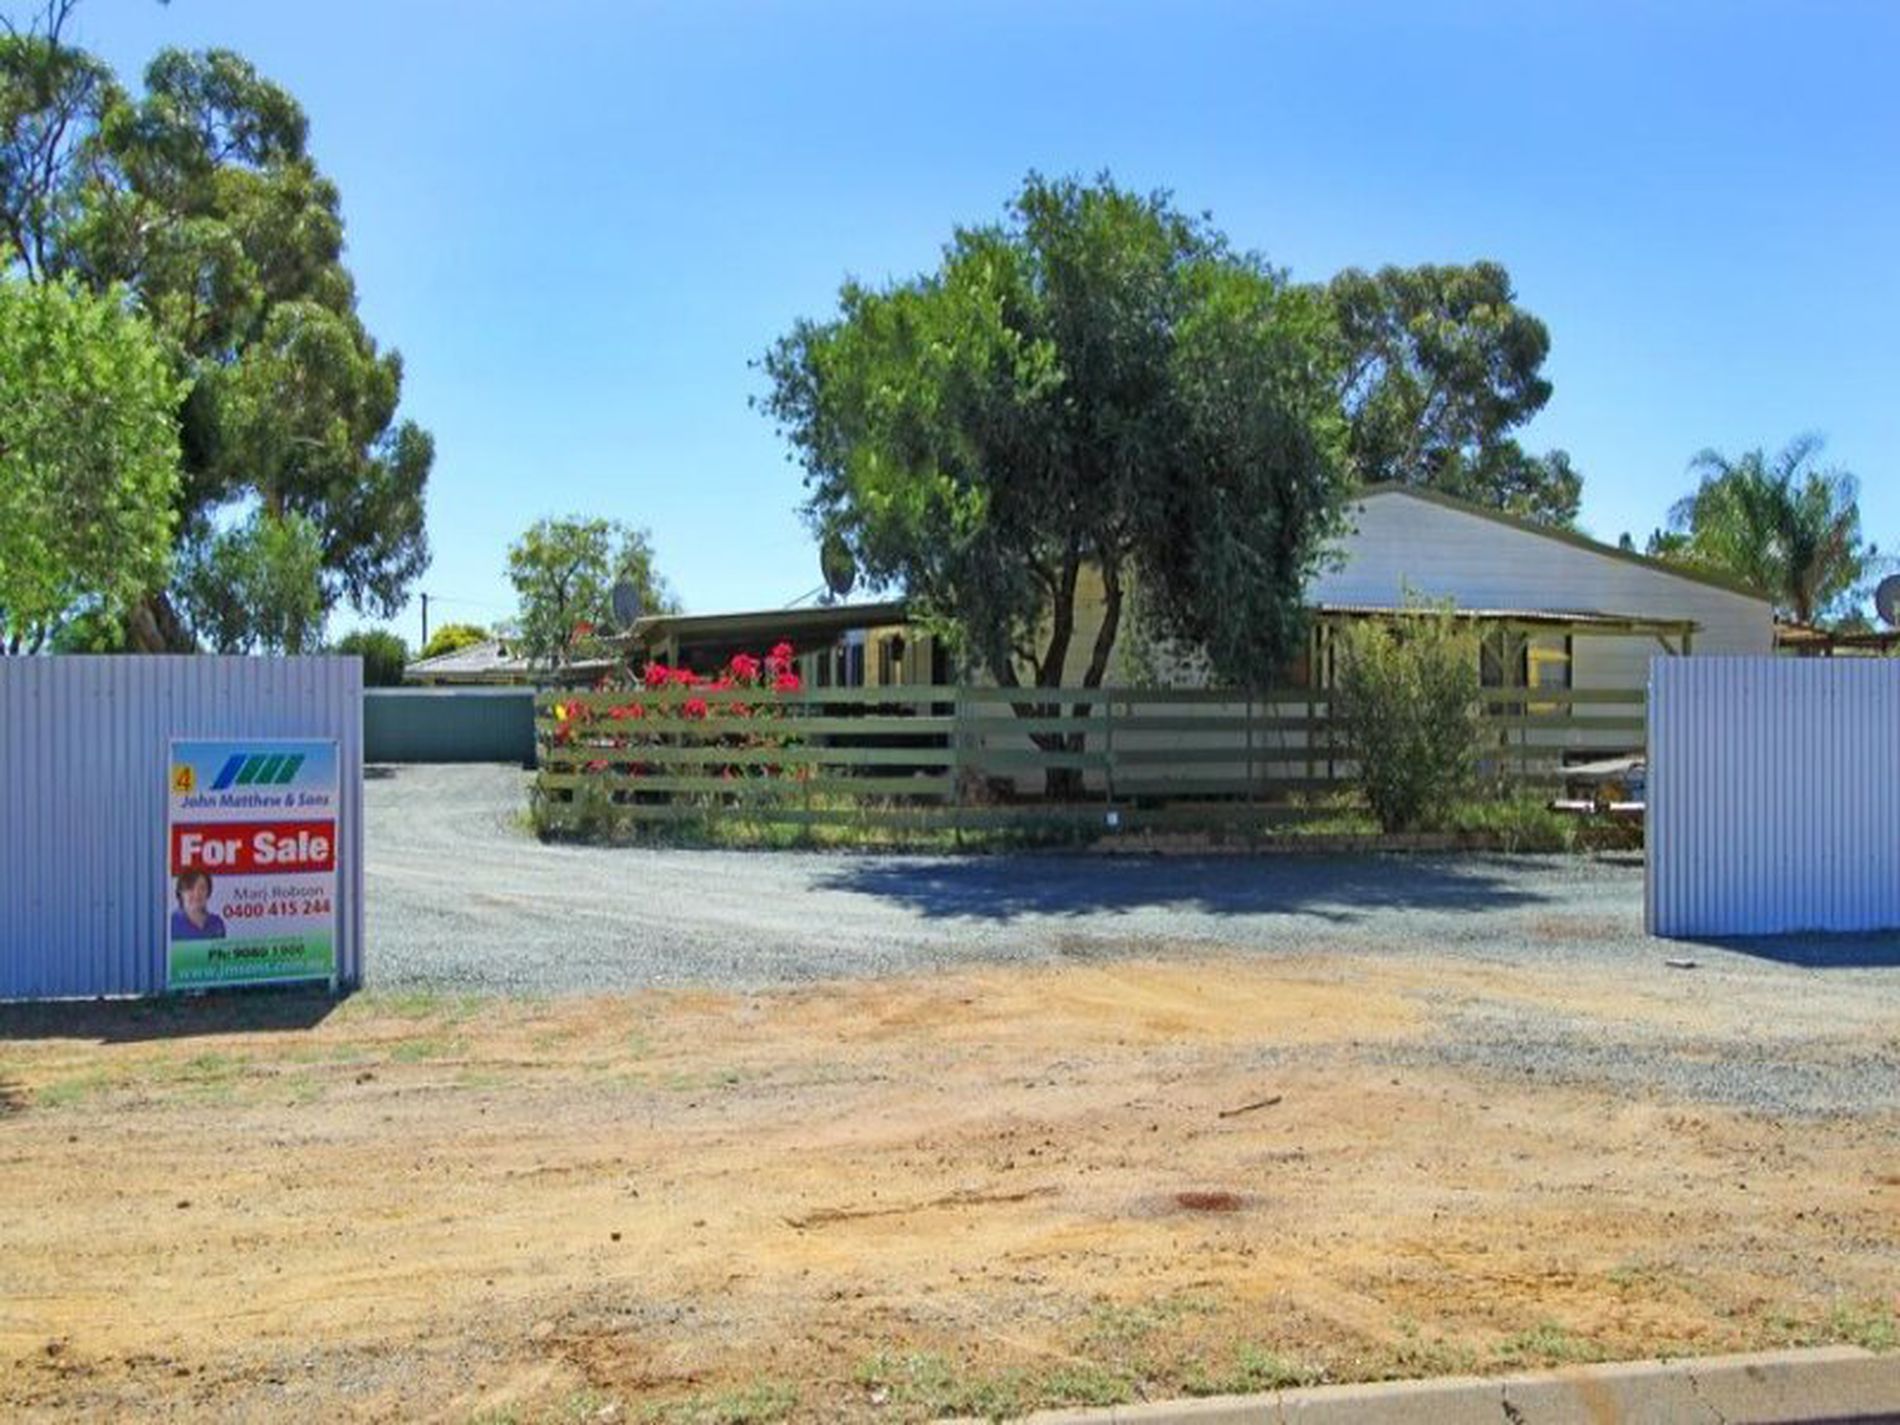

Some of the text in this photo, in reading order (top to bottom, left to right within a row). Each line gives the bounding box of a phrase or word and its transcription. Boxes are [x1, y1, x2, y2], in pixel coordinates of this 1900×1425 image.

[177, 767, 190, 791] 4
[181, 792, 329, 808] John Matthew & Sons
[180, 831, 329, 866] For Sale
[233, 886, 268, 902] Marj
[222, 903, 264, 918] 0400
[267, 901, 298, 916] 415
